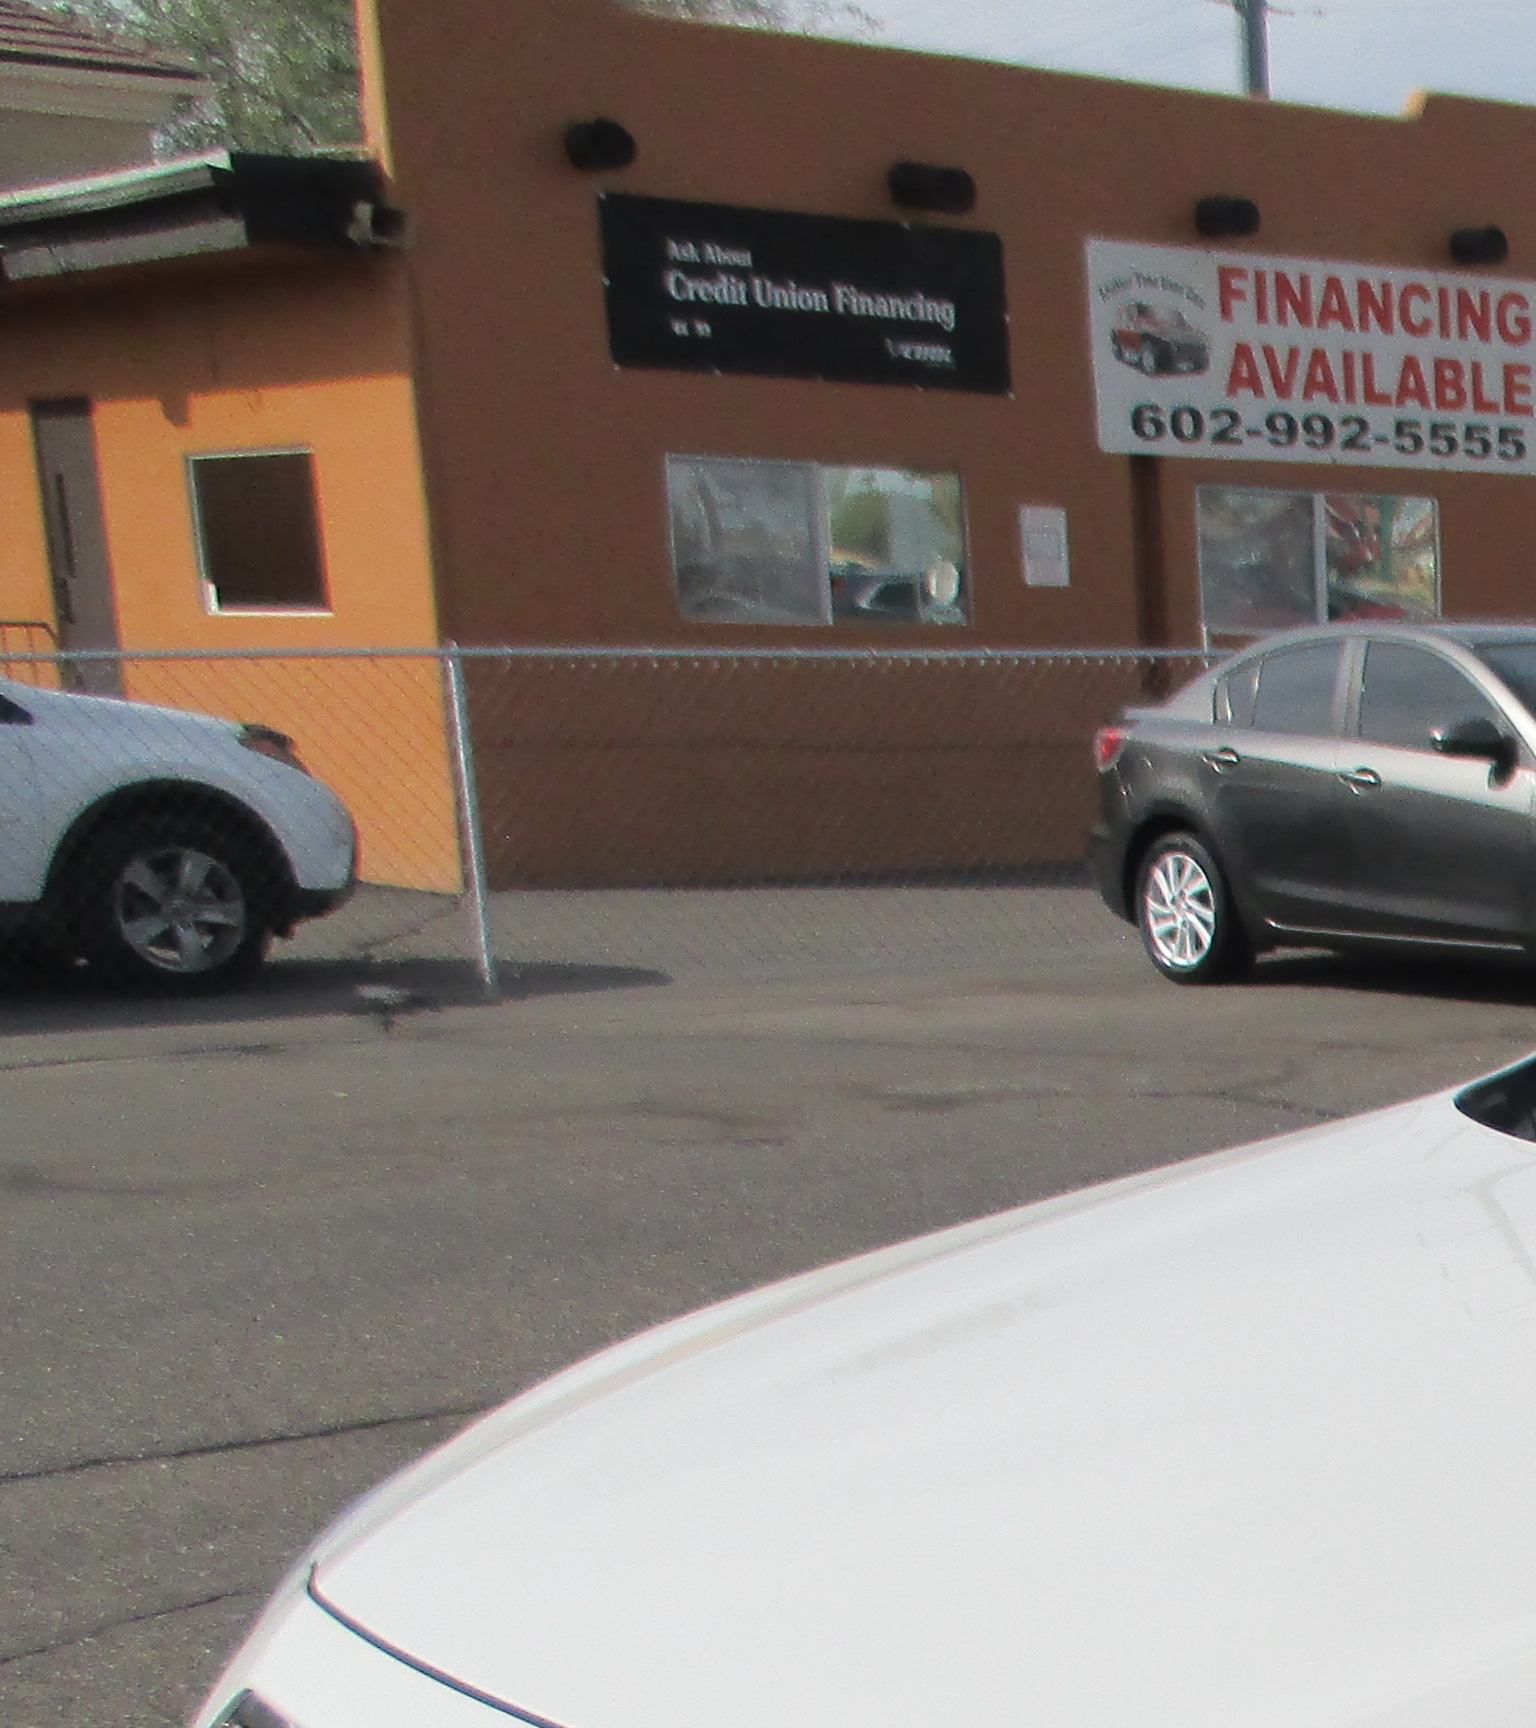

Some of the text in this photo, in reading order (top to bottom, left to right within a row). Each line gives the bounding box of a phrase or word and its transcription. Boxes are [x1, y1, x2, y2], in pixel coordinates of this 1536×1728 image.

[665, 270, 956, 333] Credit Union Financing
[1217, 266, 1533, 348] FINANCING
[1226, 342, 1535, 417] AVAILABLE
[1131, 404, 1527, 461] 602-992-5555
